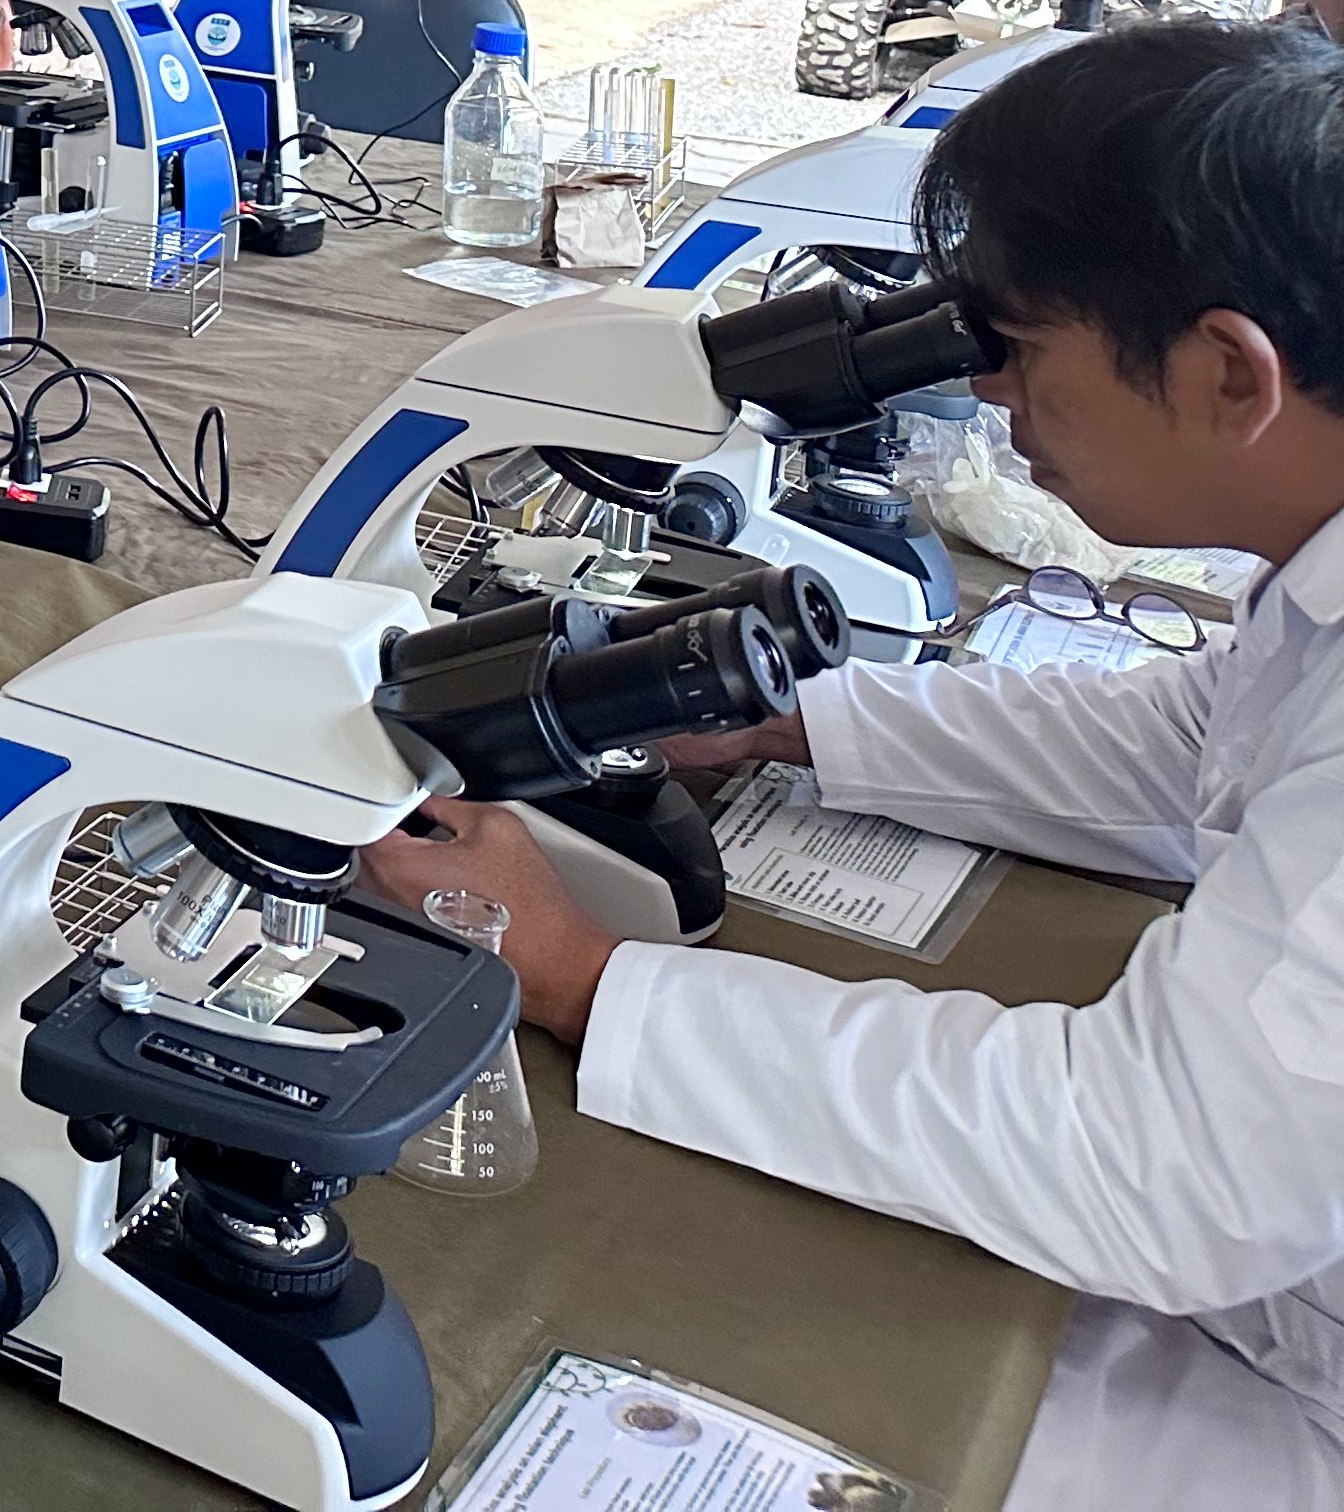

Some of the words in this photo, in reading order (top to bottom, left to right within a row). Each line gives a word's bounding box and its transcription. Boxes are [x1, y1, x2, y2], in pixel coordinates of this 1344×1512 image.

[474, 1070, 492, 1083] 00
[470, 1108, 494, 1122] 150
[471, 1142, 495, 1155] 100
[478, 1165, 495, 1179] 50
